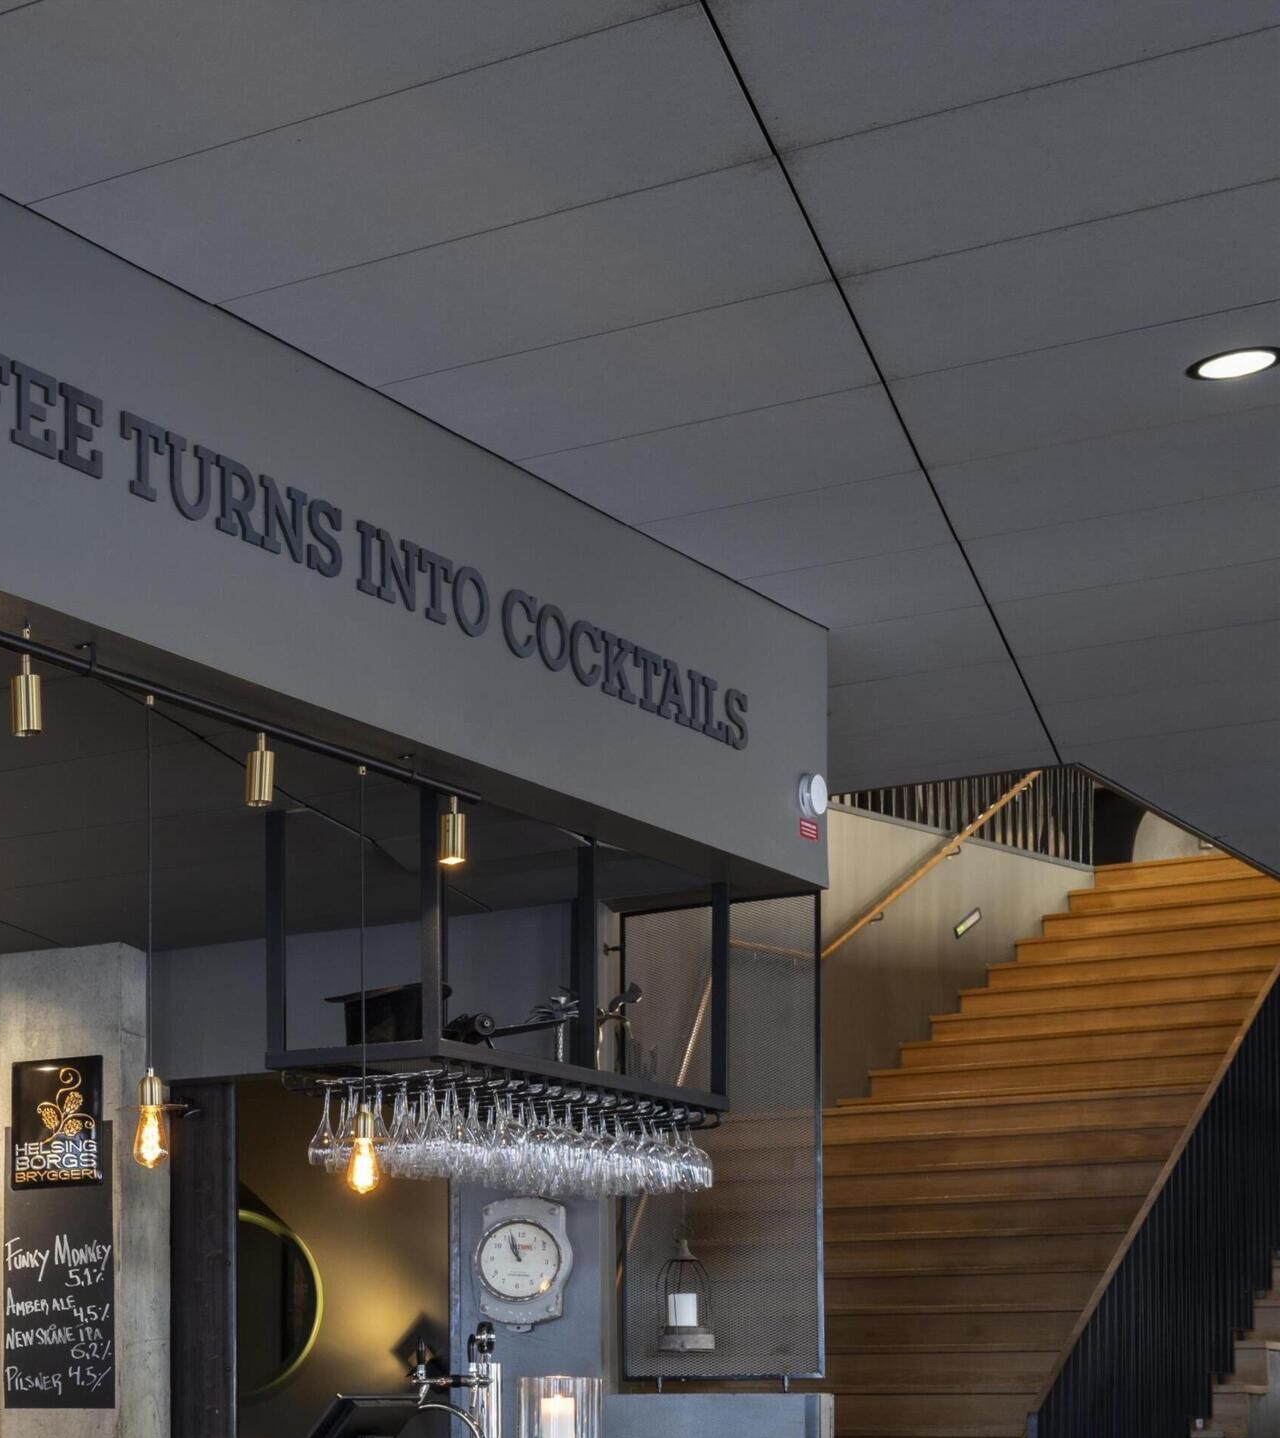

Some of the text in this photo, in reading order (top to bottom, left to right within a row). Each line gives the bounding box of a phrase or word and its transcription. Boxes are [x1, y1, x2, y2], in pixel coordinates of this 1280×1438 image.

[119, 411, 342, 579] TURNS
[356, 520, 490, 639] INTO
[501, 588, 749, 752] COCKTAILS
[15, 1139, 97, 1157] HELSING
[15, 1152, 97, 1172] BORGS
[15, 1168, 97, 1183] BRYGGERI
[52, 1295, 76, 1311] ALE
[5, 1327, 34, 1350] NEW
